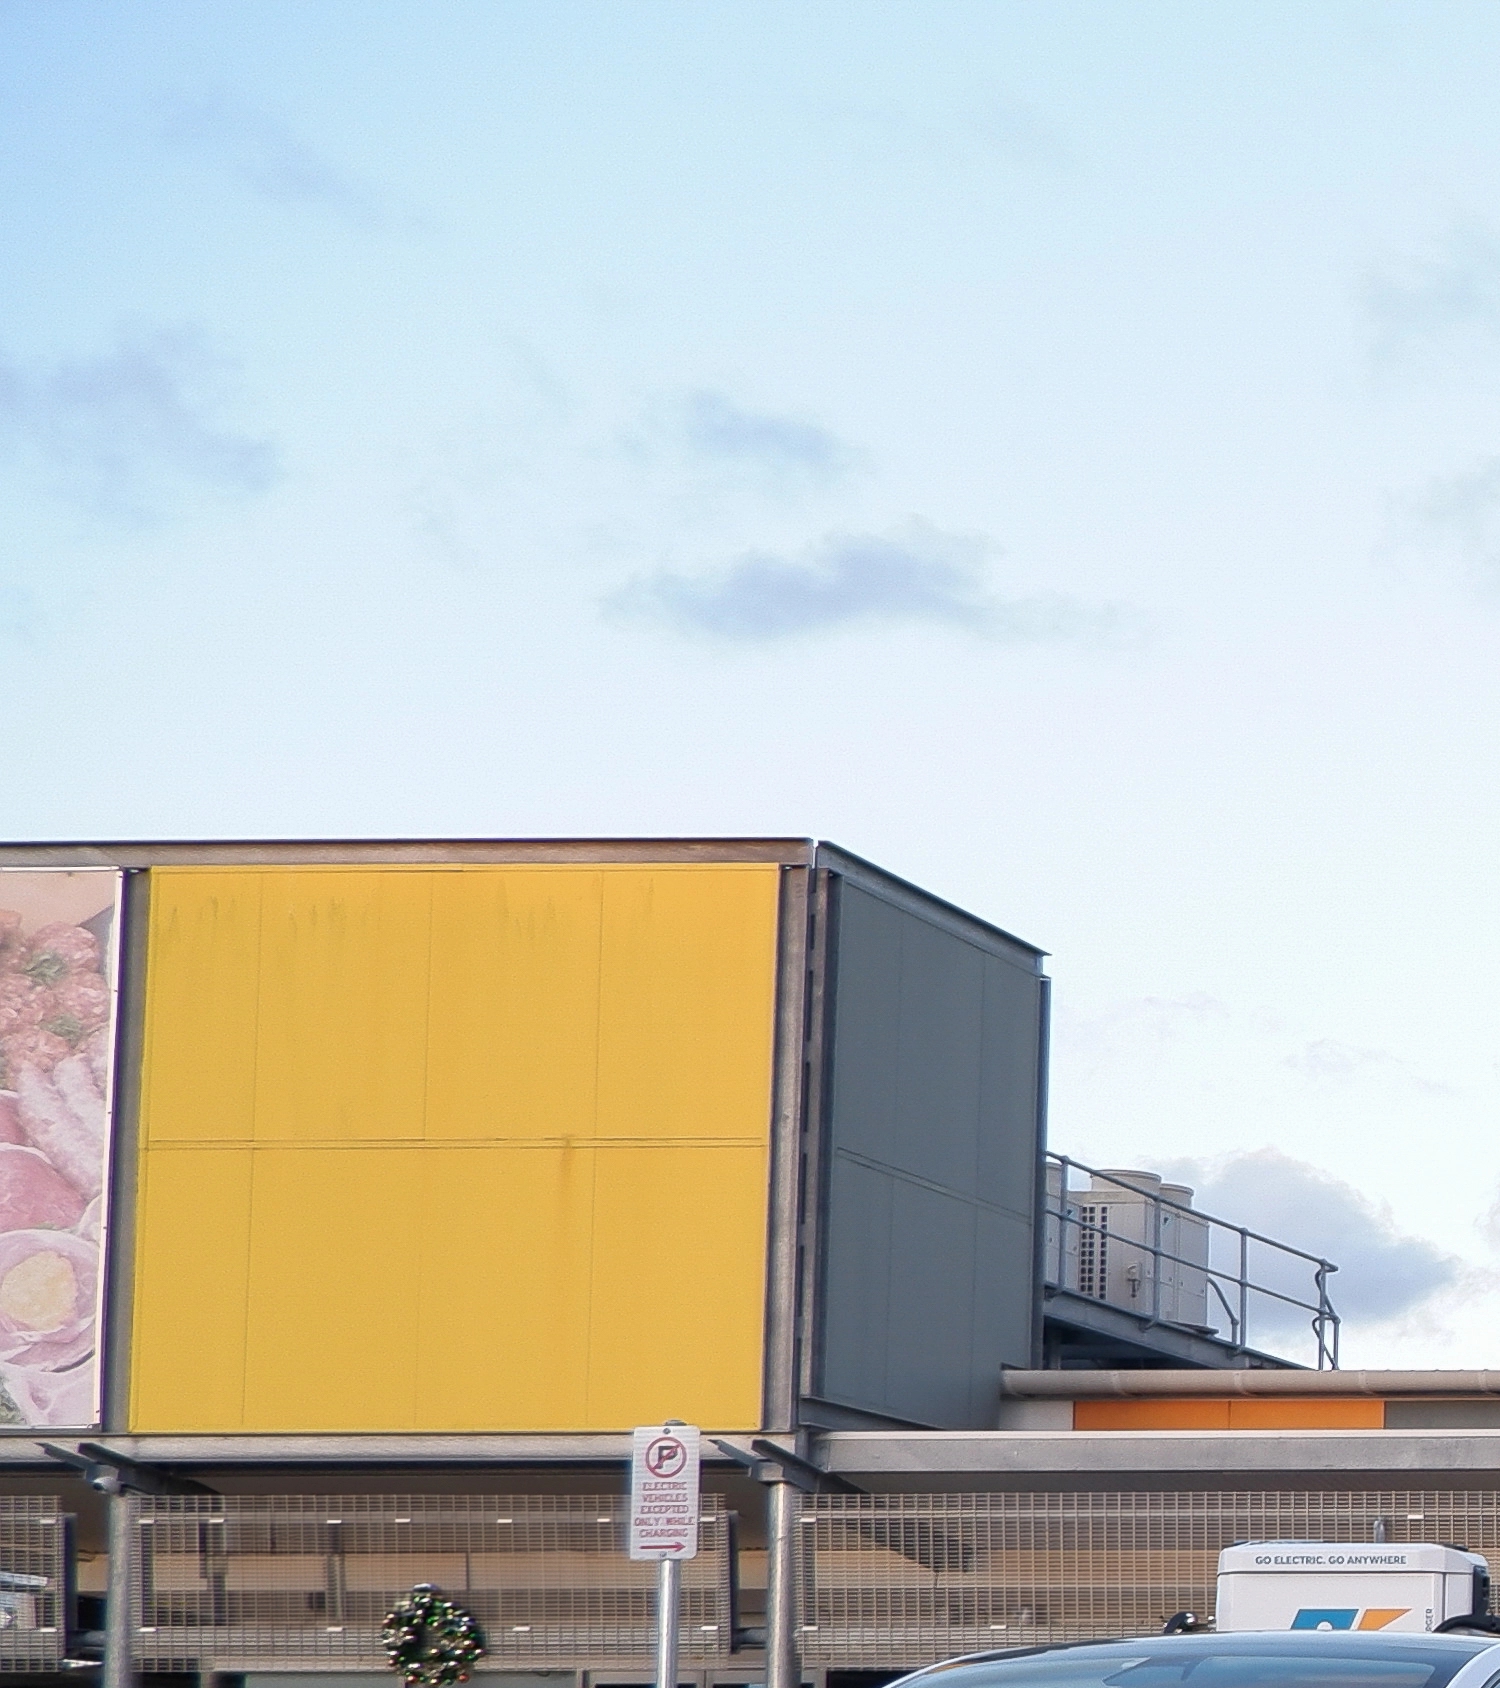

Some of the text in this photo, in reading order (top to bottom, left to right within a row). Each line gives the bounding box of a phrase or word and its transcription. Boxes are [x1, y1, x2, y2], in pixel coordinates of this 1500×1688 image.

[642, 1482, 687, 1491] ELECTRIC
[642, 1493, 688, 1503] VEHICLES
[634, 1517, 660, 1527] ONLY
[639, 1528, 688, 1538] CHARGING
[1255, 1555, 1407, 1565] GO ELECTRIC. GO ANYWHERE
